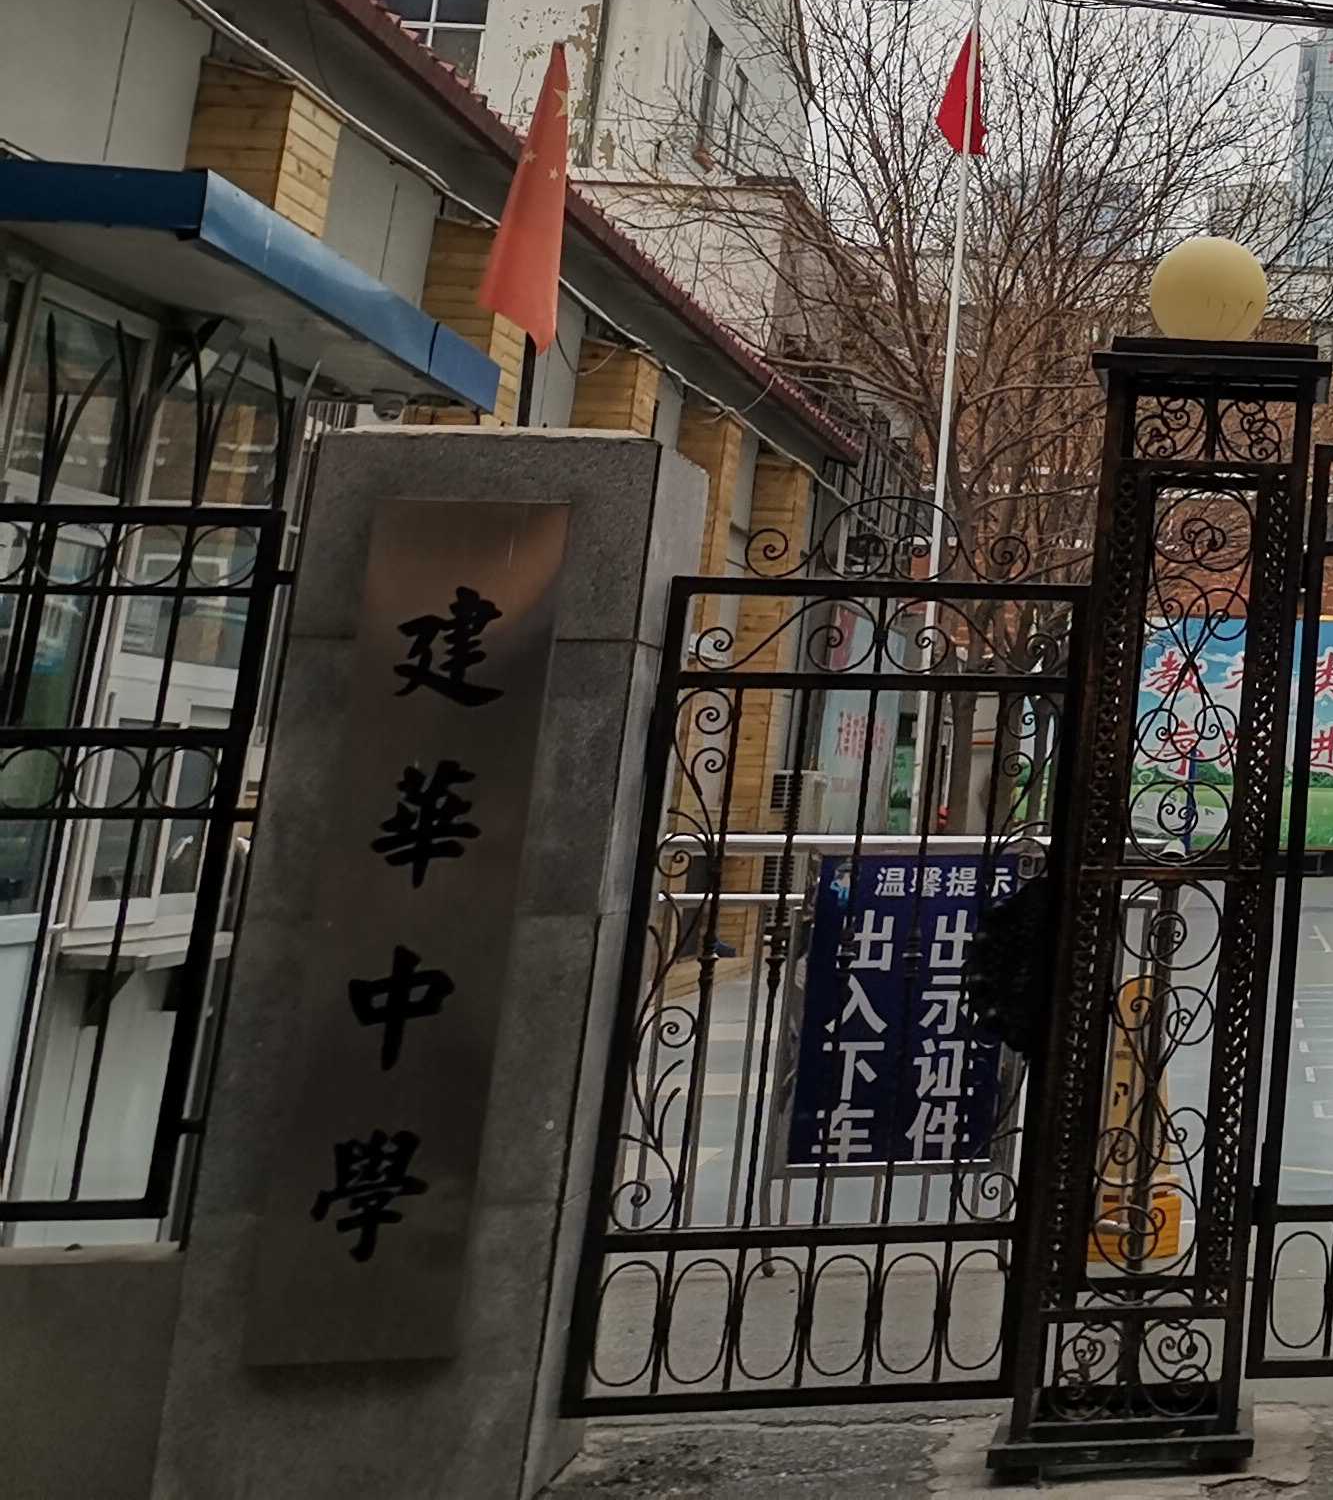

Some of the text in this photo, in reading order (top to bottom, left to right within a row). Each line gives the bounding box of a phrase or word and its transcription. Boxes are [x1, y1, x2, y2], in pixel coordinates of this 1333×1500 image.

[310, 586, 505, 1263] 建華中學
[874, 866, 1013, 898] 温馨提示
